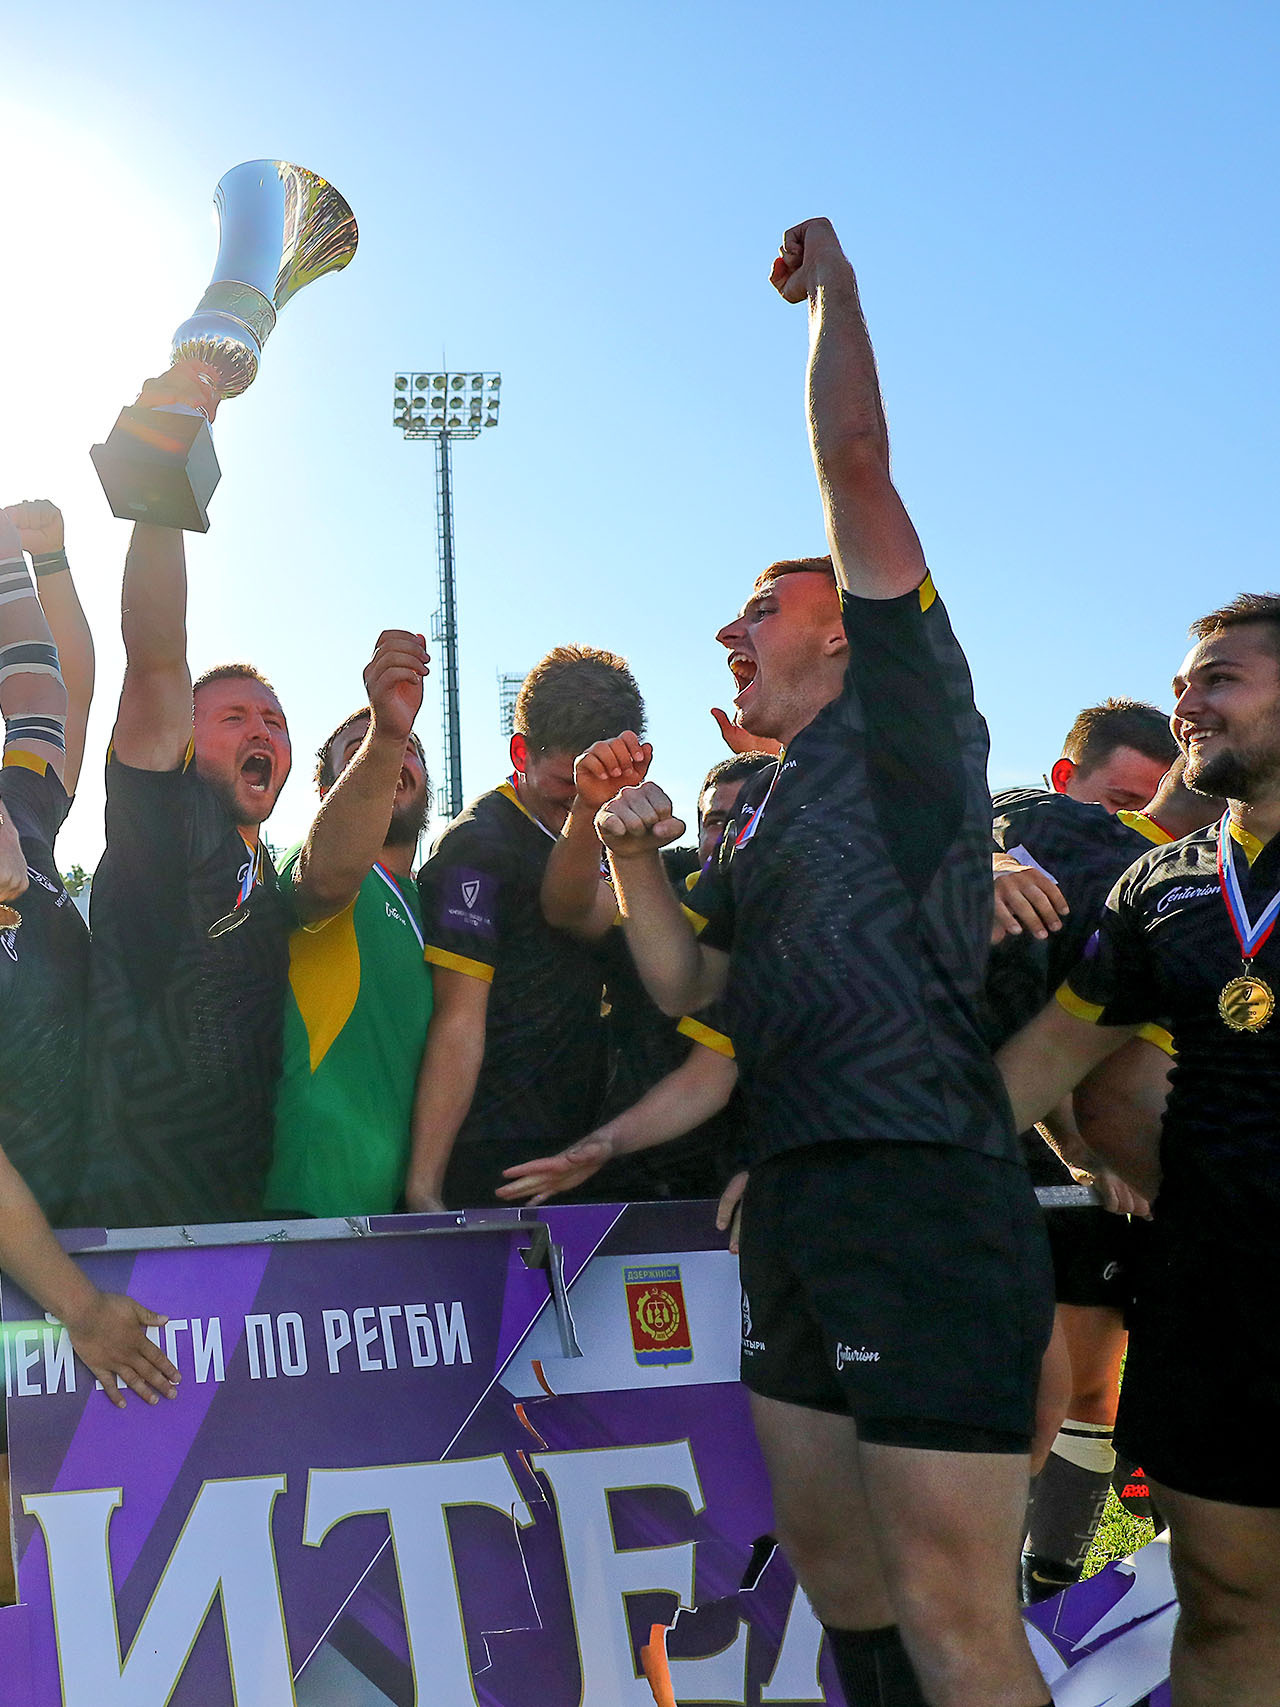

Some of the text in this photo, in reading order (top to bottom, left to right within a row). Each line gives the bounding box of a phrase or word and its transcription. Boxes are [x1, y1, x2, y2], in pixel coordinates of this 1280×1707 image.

[1156, 884, 1221, 913] Centurion
[627, 1269, 677, 1281] ДЗЕРЖИНСК
[244, 1312, 309, 1380] ПО
[322, 1301, 473, 1374] РЕГБИ
